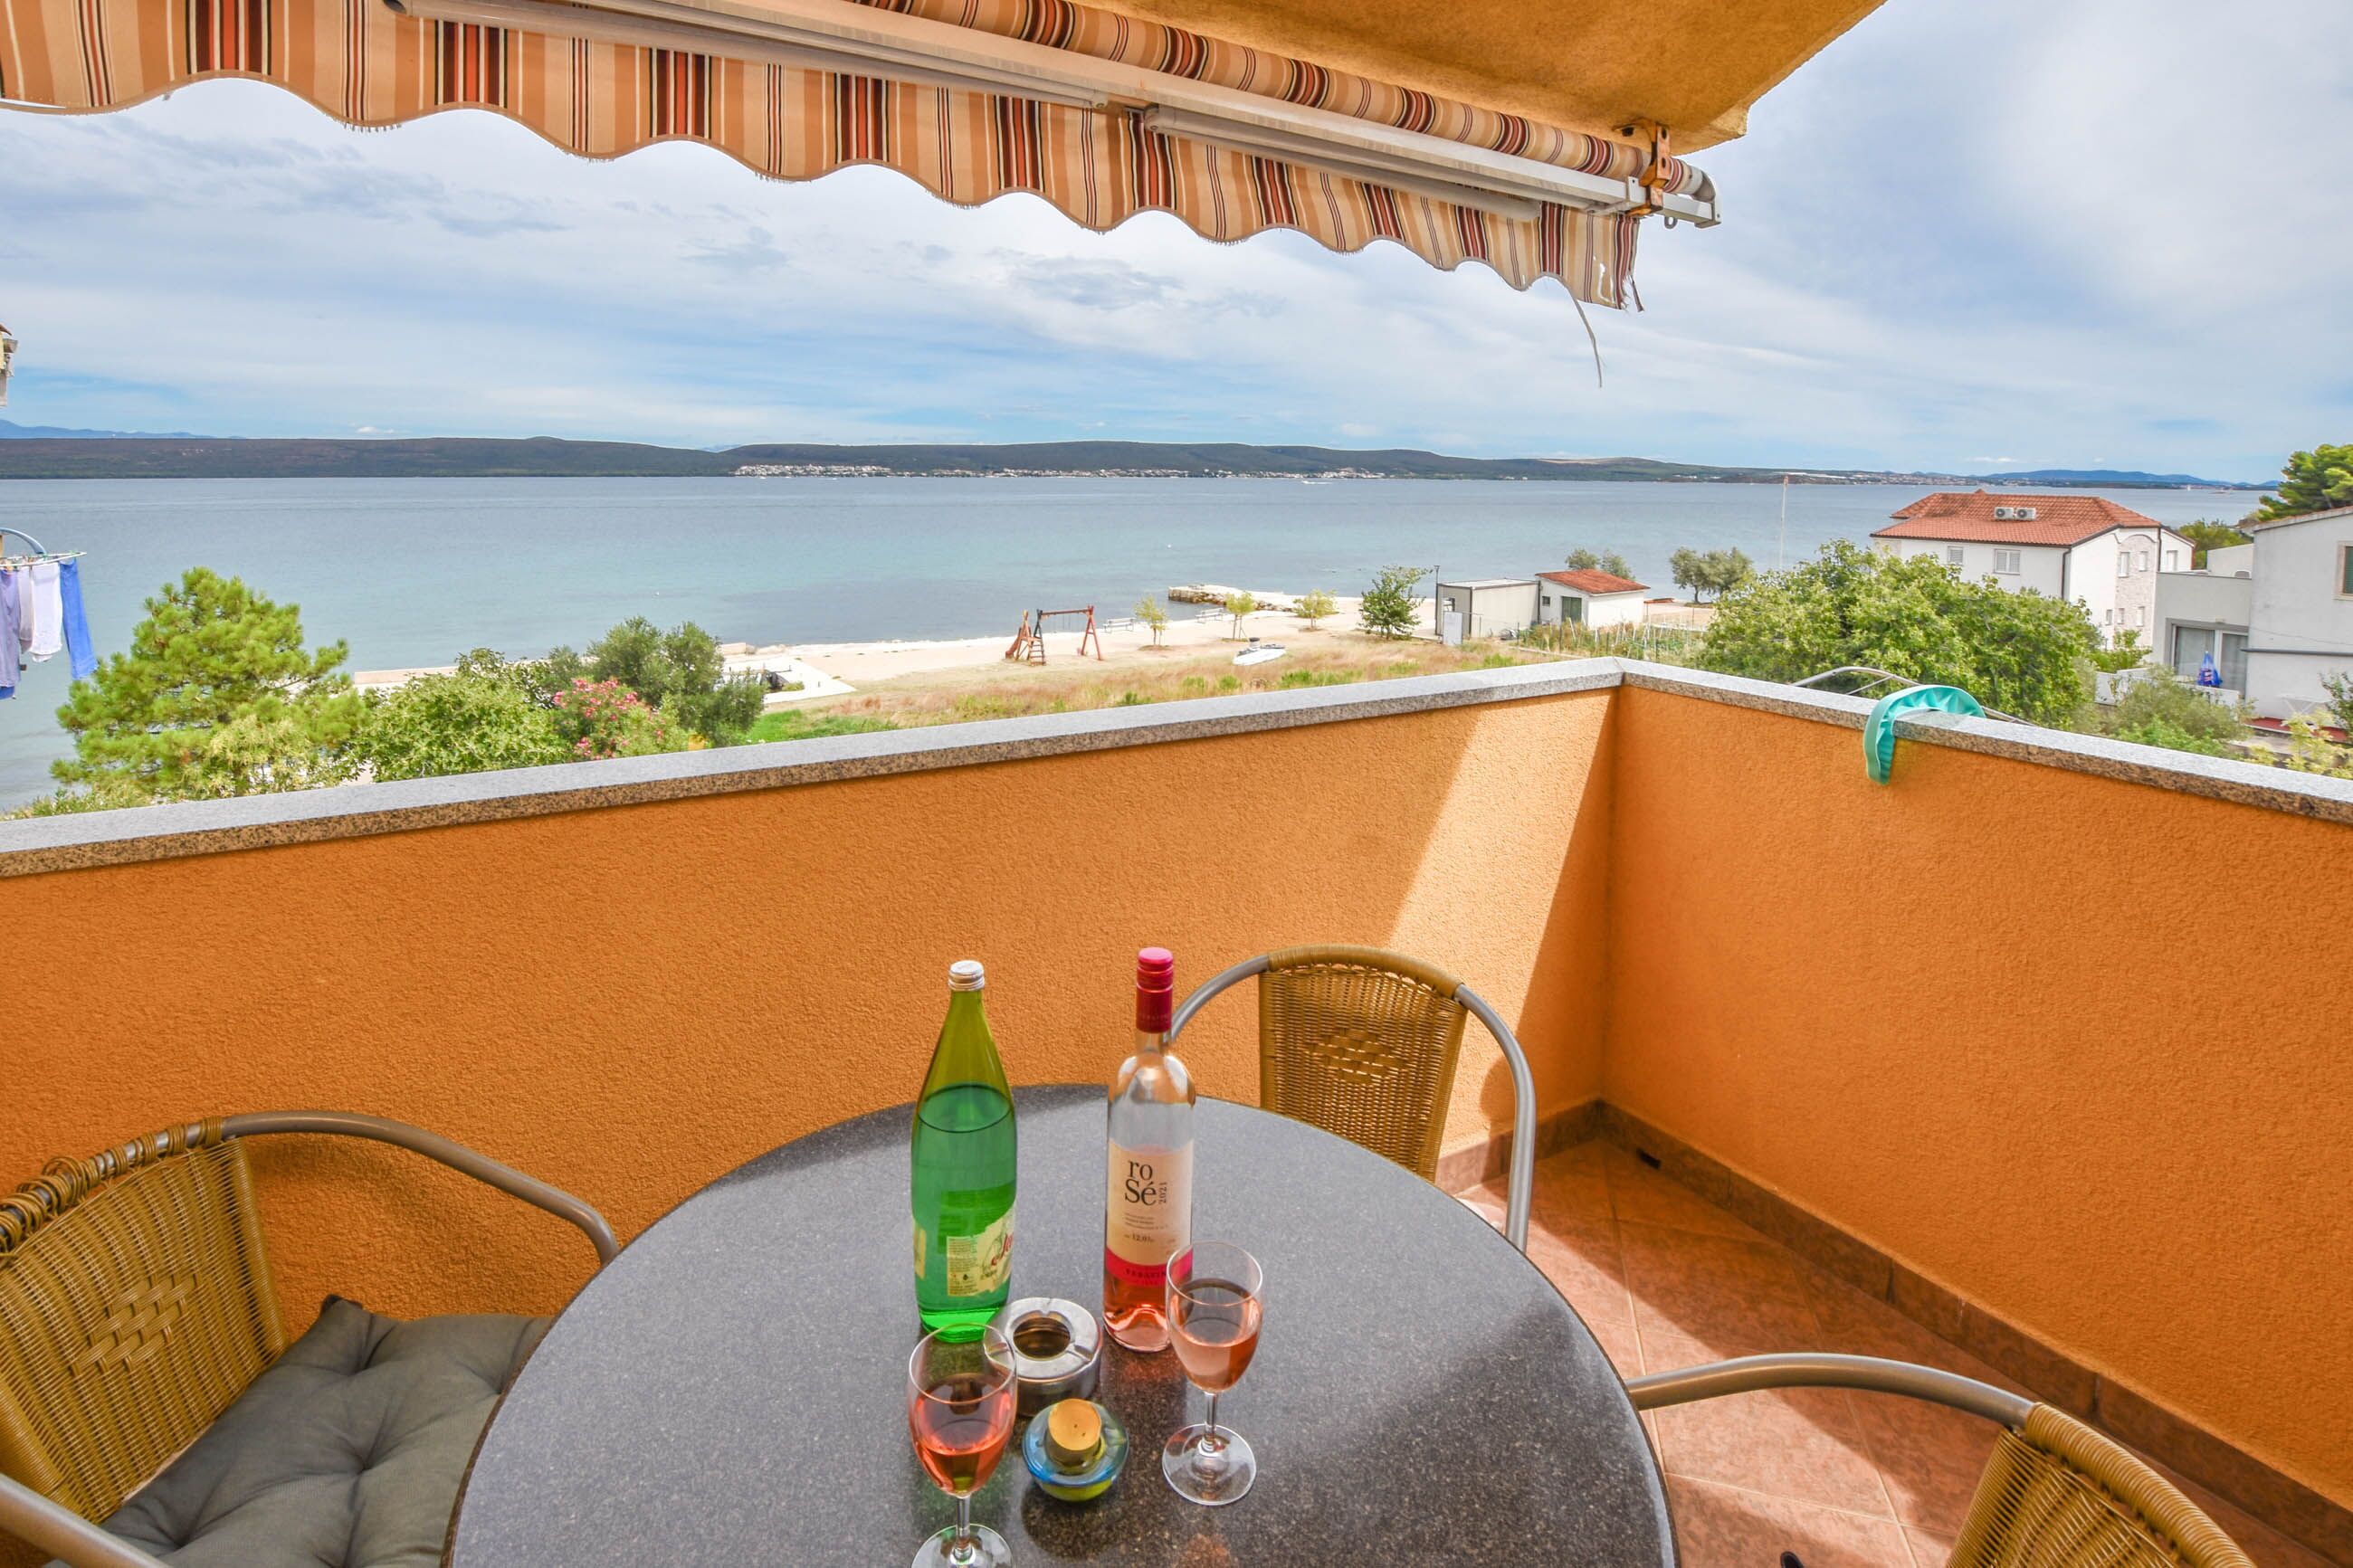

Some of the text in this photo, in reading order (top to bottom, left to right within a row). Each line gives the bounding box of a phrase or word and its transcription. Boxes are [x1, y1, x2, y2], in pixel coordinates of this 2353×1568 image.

[1128, 1160, 1153, 1181] ro
[1124, 1178, 1157, 1206] Sé
[1158, 1182, 1167, 1204] 2021
